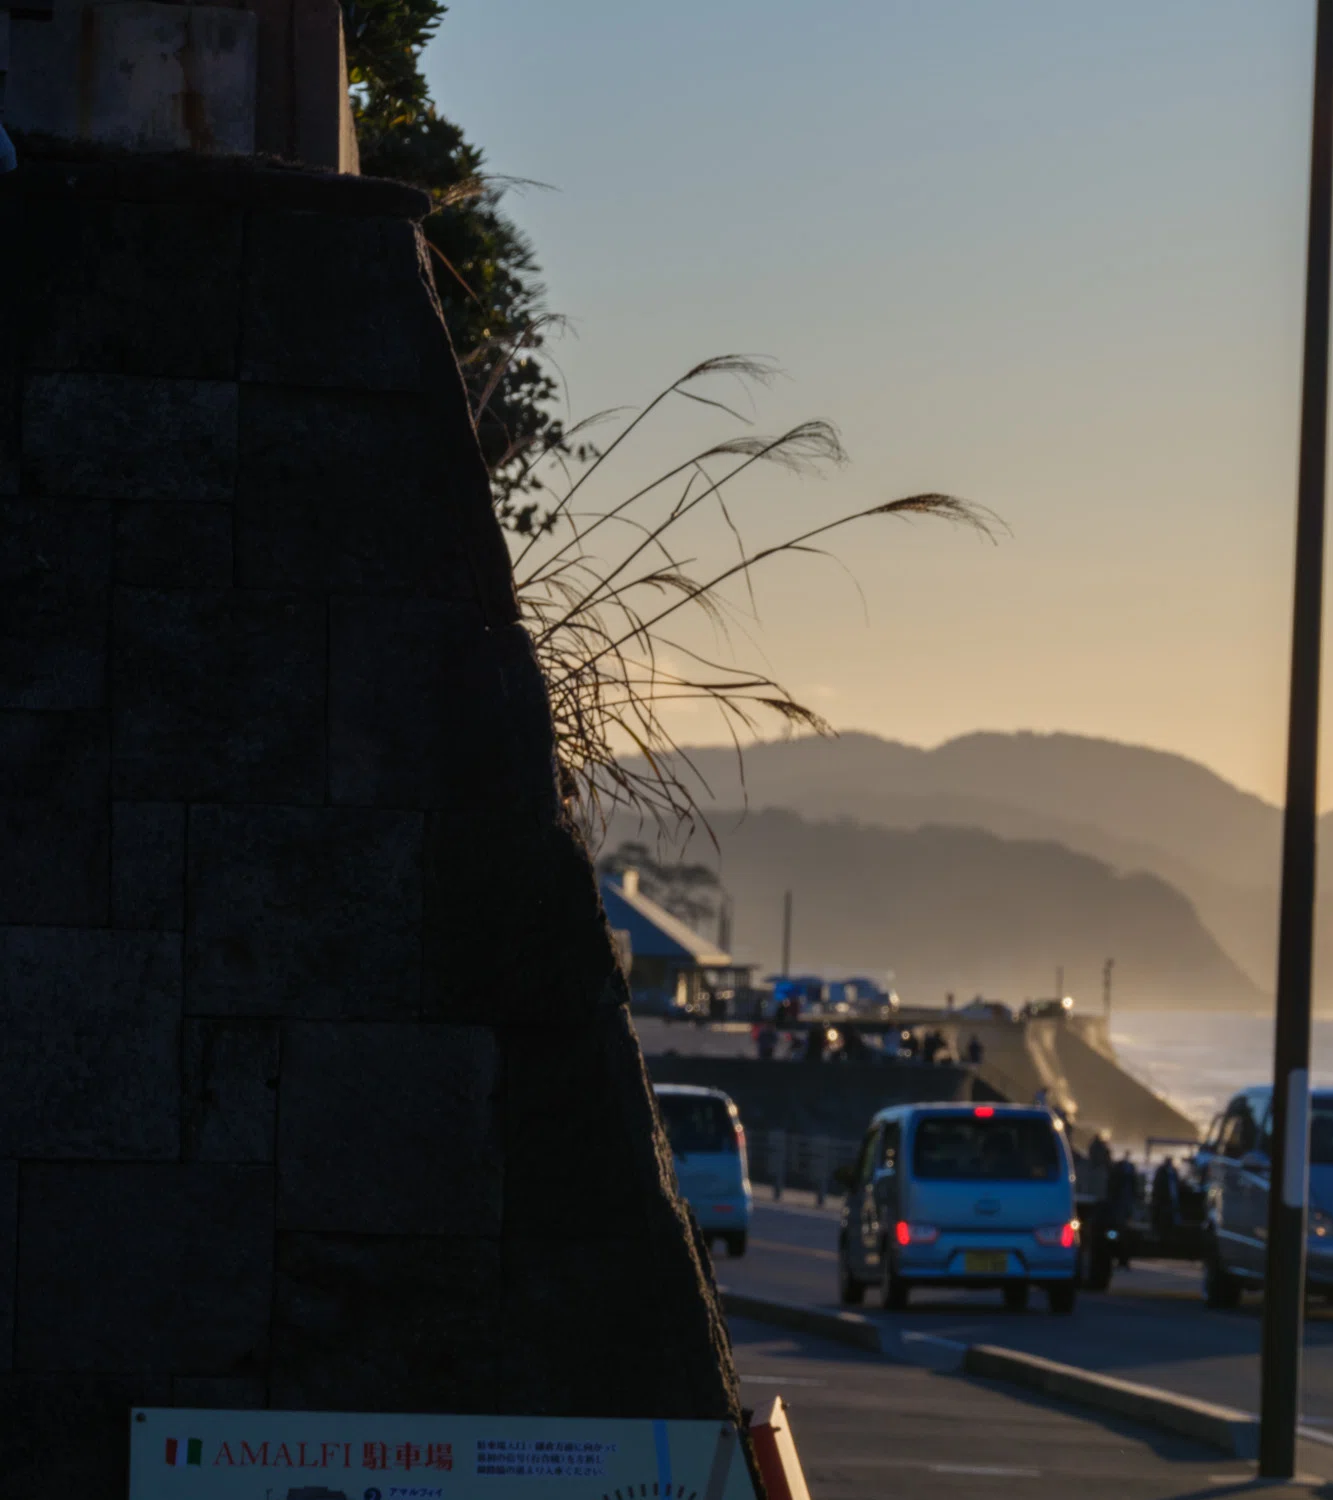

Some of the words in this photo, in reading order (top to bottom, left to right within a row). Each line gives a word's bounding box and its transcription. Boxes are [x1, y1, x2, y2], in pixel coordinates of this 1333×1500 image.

[212, 1441, 352, 1468] AMALFI
[362, 1442, 453, 1471] 駐車場
